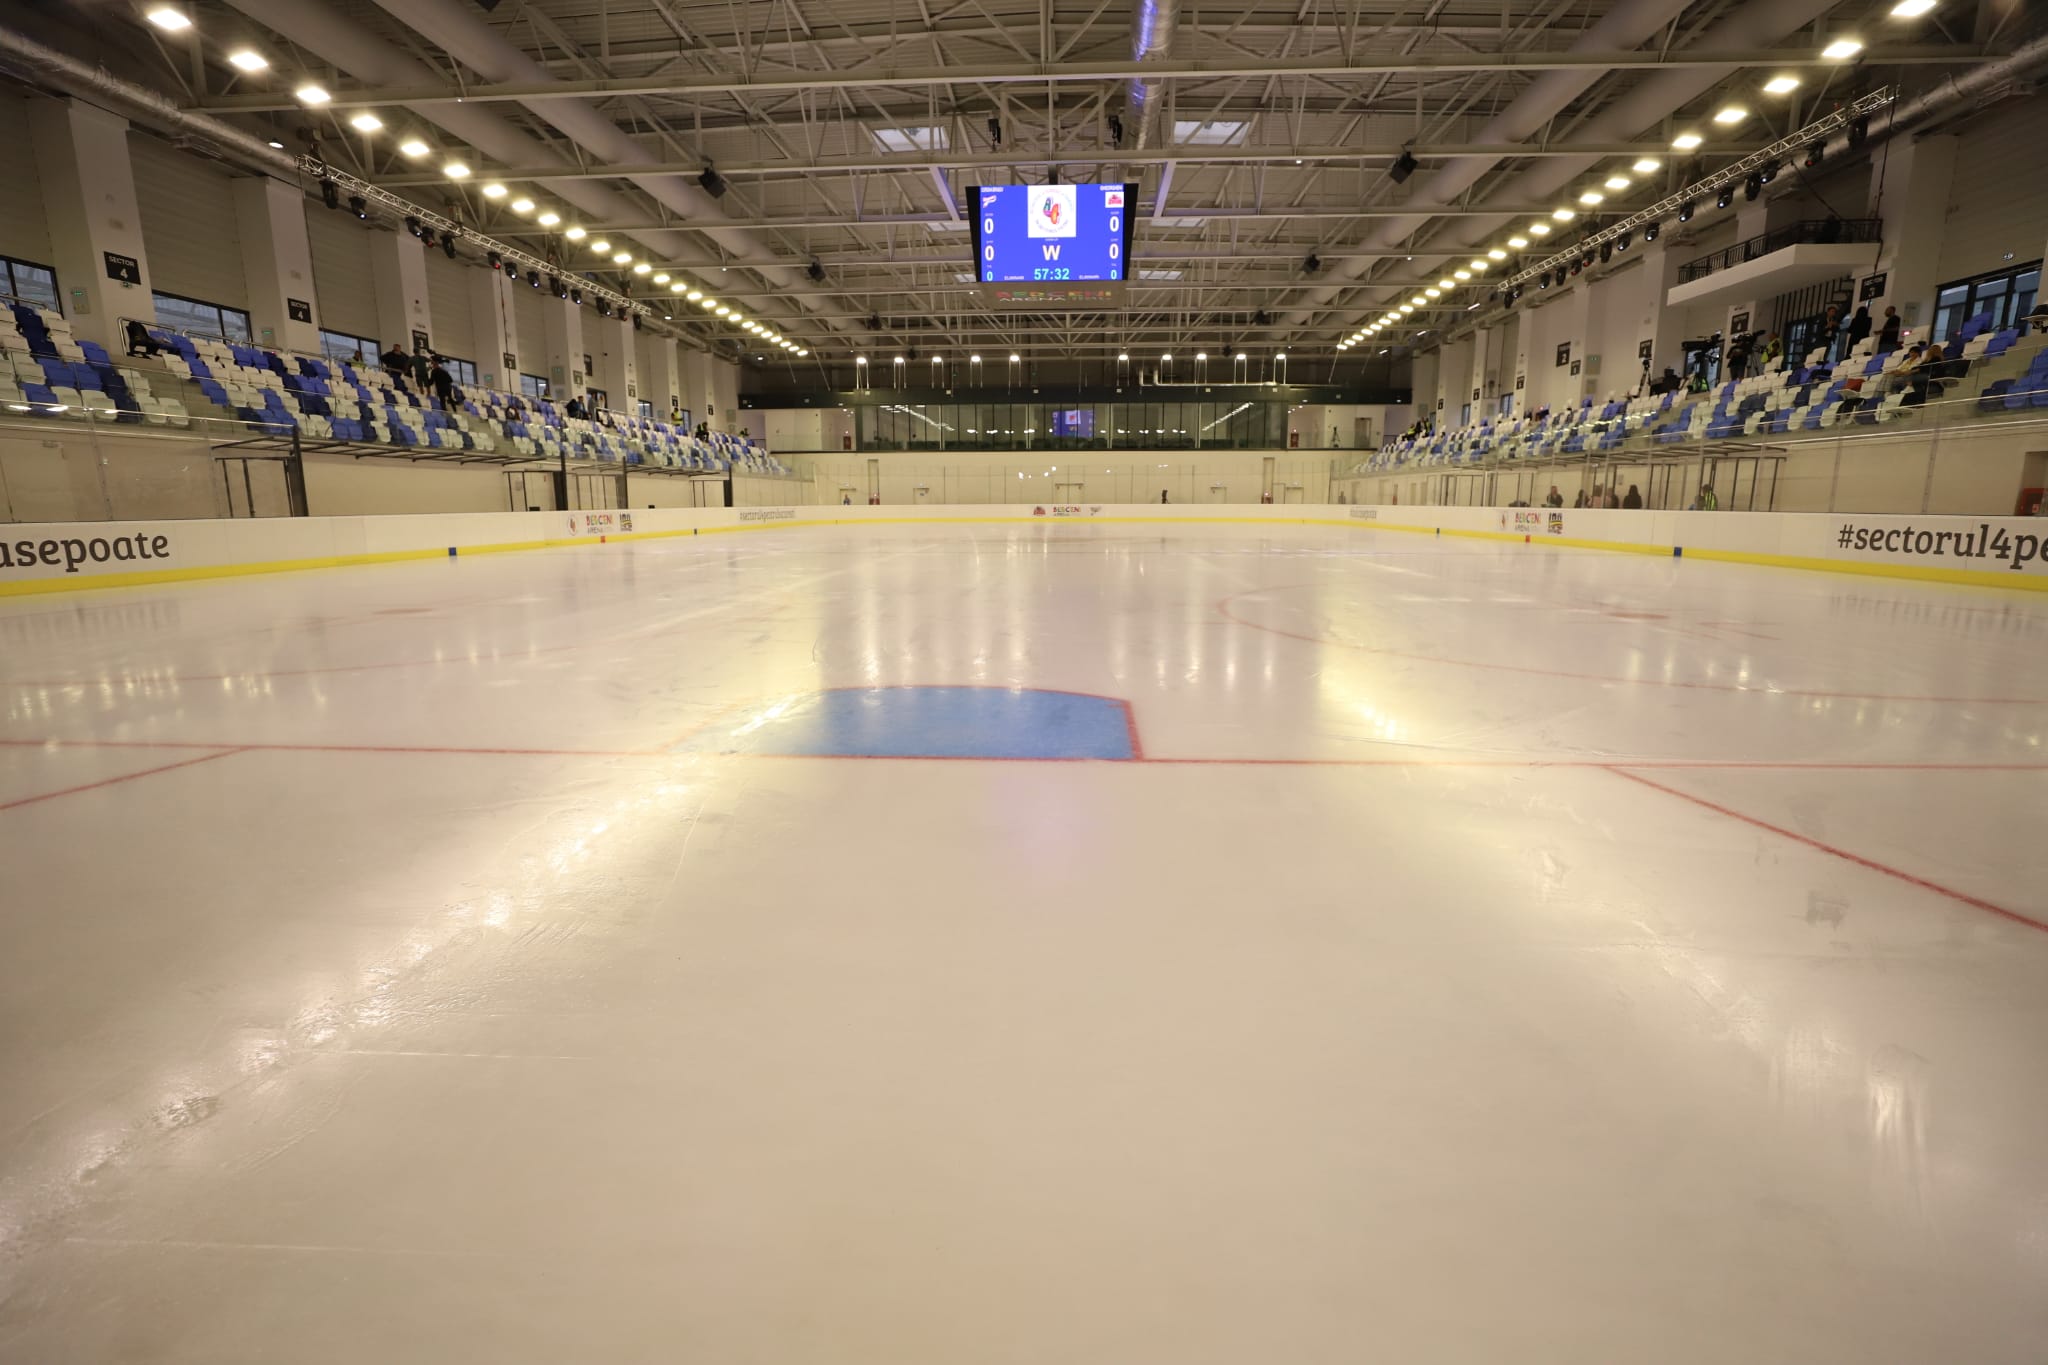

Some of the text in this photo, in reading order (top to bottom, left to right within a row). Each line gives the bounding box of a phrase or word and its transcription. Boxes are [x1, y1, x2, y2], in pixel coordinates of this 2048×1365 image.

[985, 216, 1119, 234] 0 0
[985, 243, 1119, 261] 0 W 0
[120, 268, 128, 279] 4
[987, 271, 993, 282] 0
[1034, 268, 1070, 280] 57:32
[1111, 269, 1117, 280] 0
